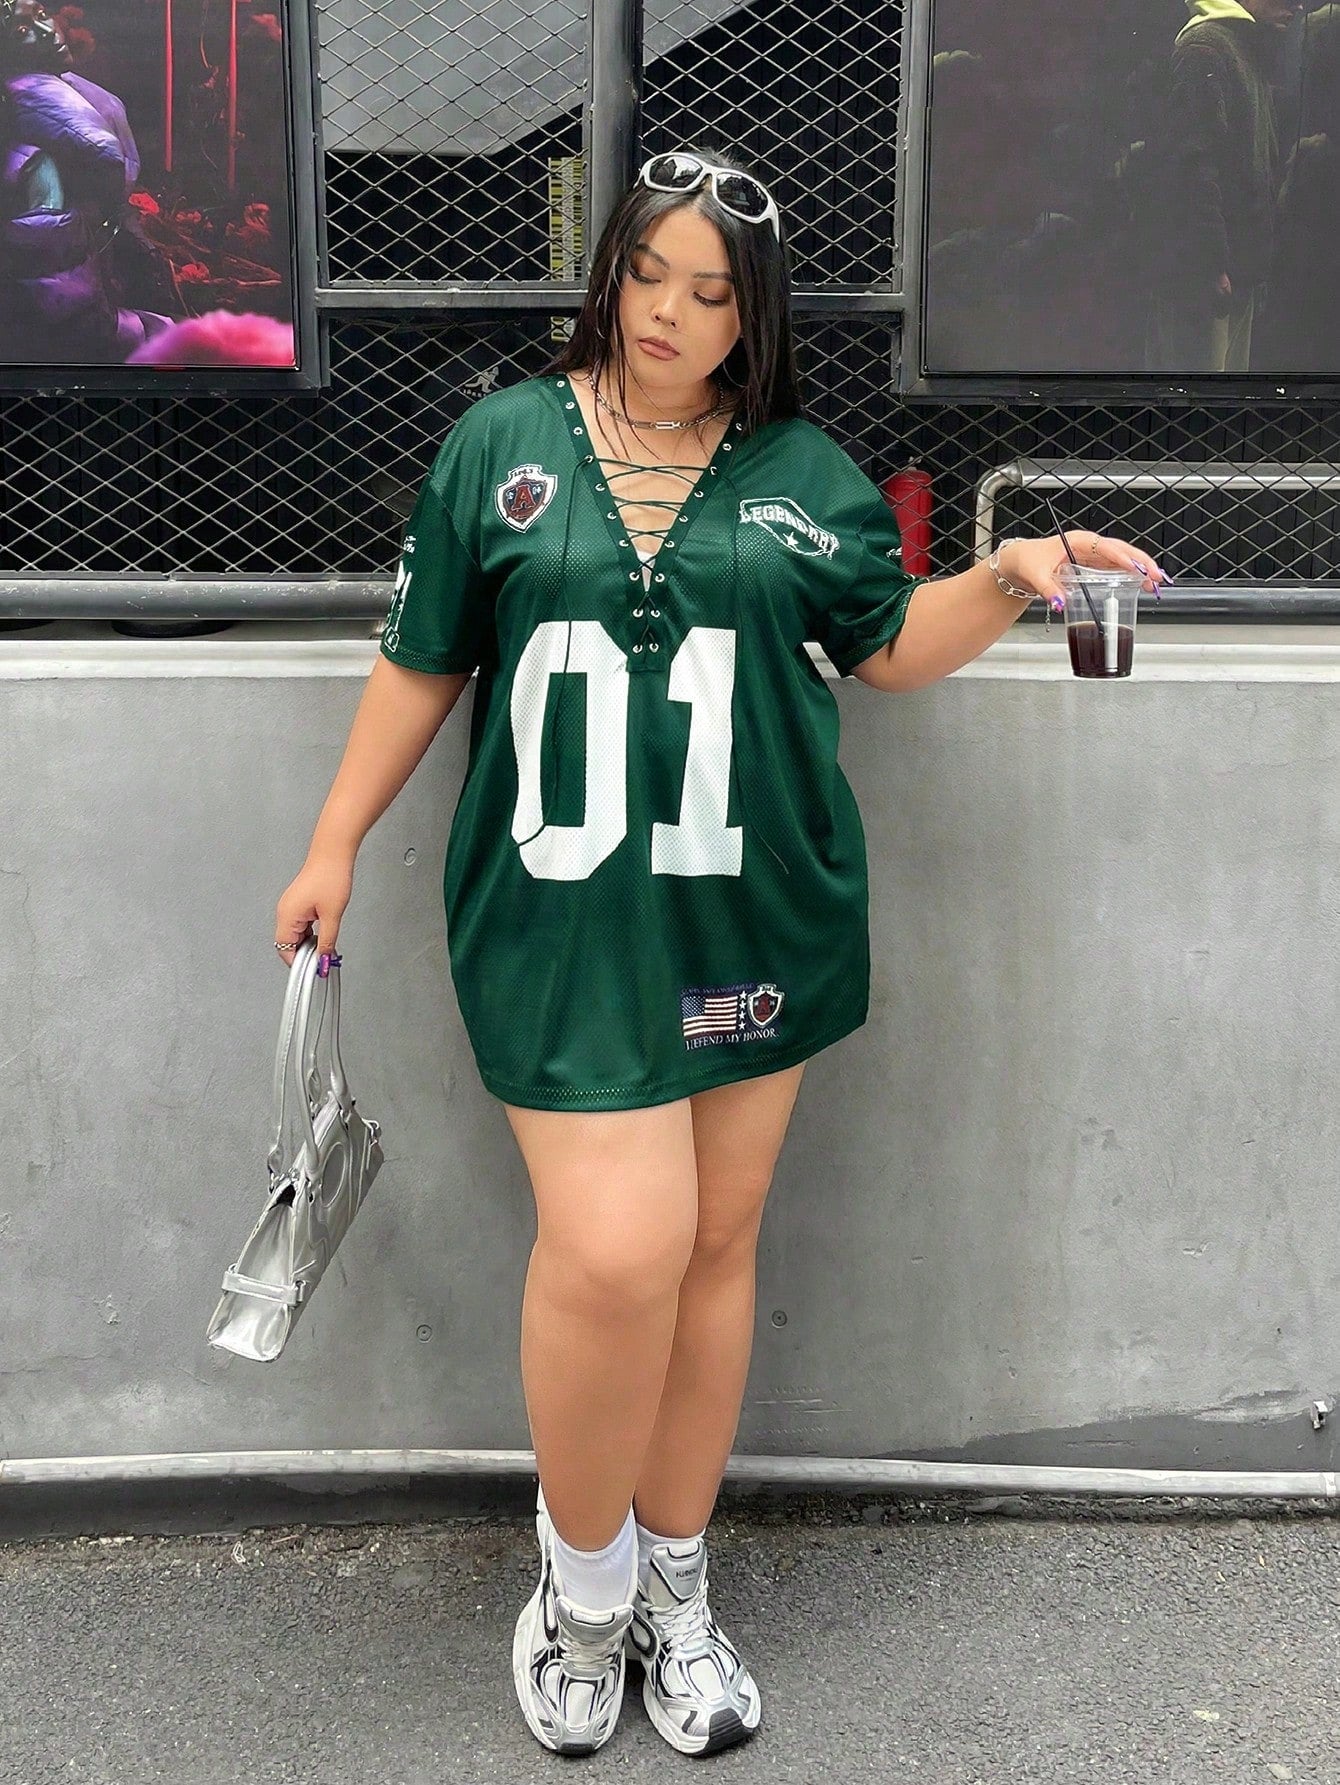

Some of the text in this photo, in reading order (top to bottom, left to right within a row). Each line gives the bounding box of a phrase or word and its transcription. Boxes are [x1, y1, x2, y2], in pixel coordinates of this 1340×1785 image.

[511, 485, 536, 511] A
[510, 620, 743, 881] 01
[725, 1034, 740, 1043] MY
